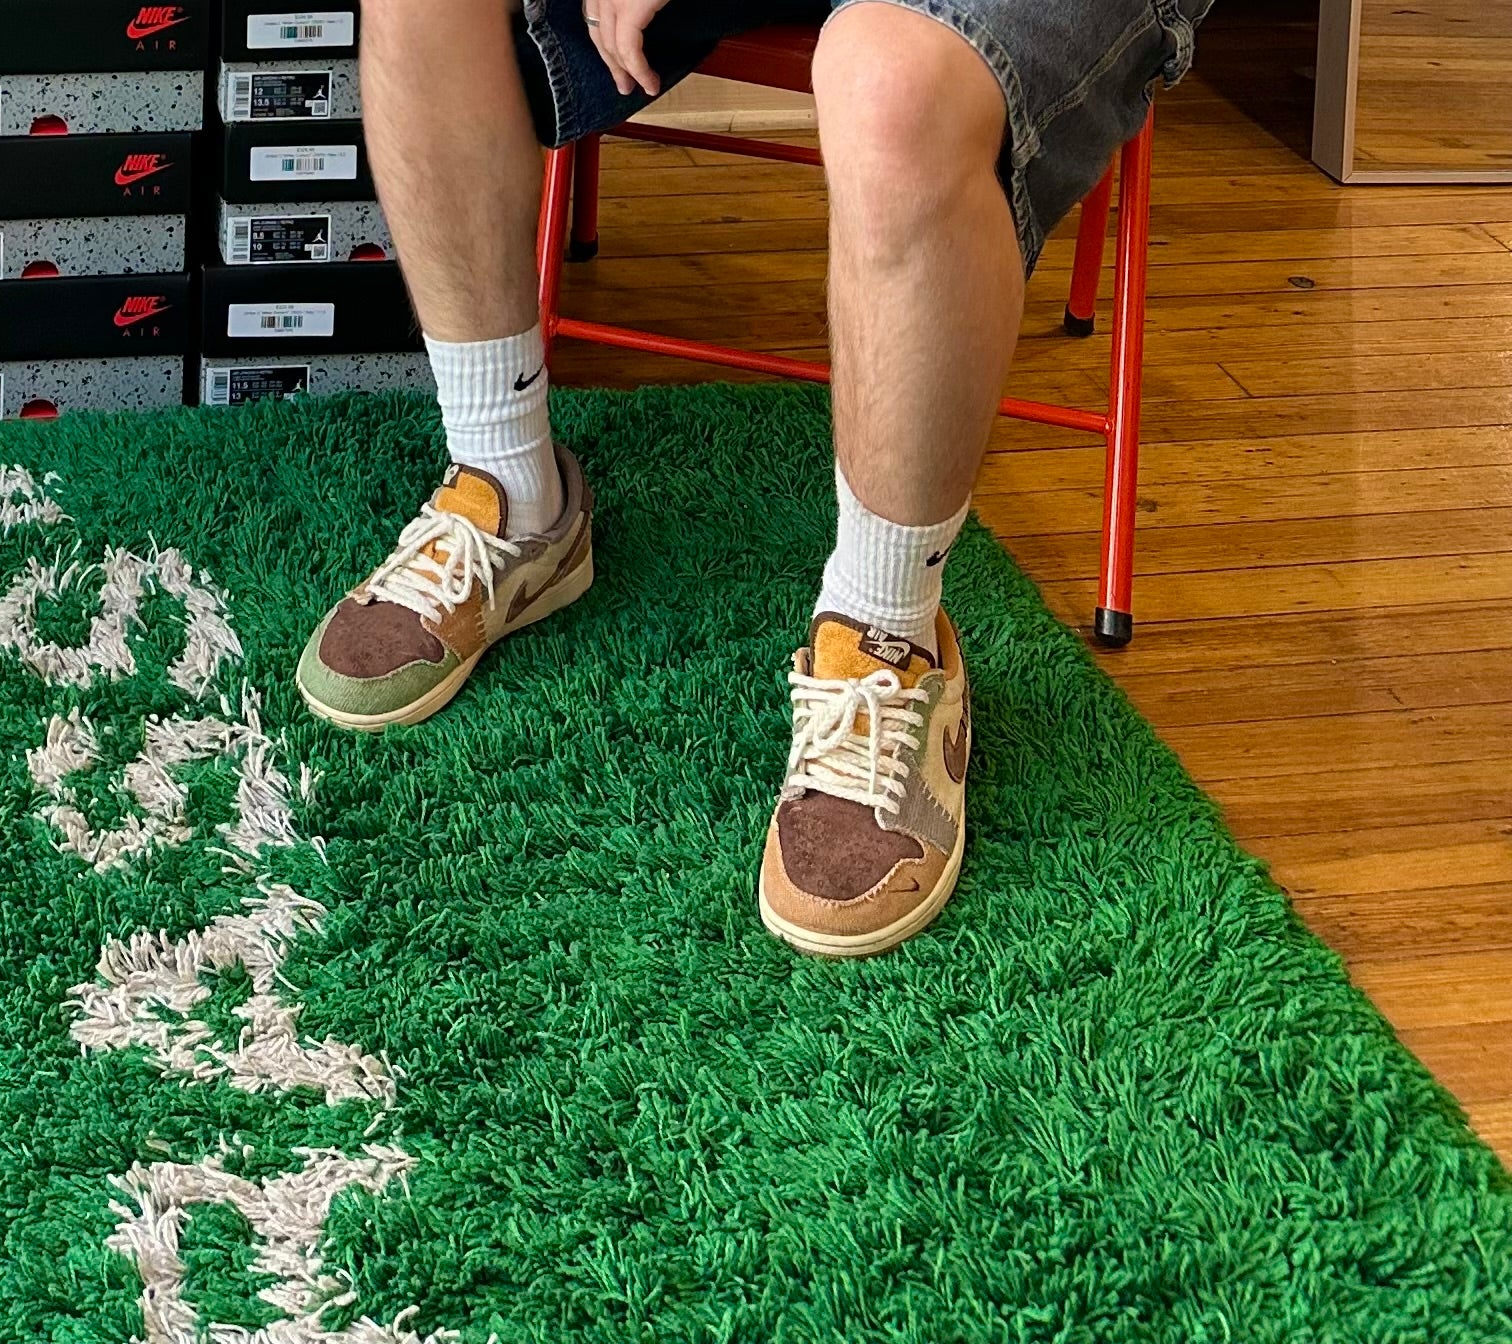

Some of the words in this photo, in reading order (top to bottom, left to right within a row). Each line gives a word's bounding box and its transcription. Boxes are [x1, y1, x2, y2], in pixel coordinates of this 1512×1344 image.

[136, 6, 178, 25] NIKE
[135, 40, 177, 51] AIR
[124, 154, 164, 172] NIKE
[123, 186, 163, 196] AIR
[122, 296, 162, 313] NIKE
[122, 327, 162, 337] AIR
[874, 644, 905, 665] NIKE
